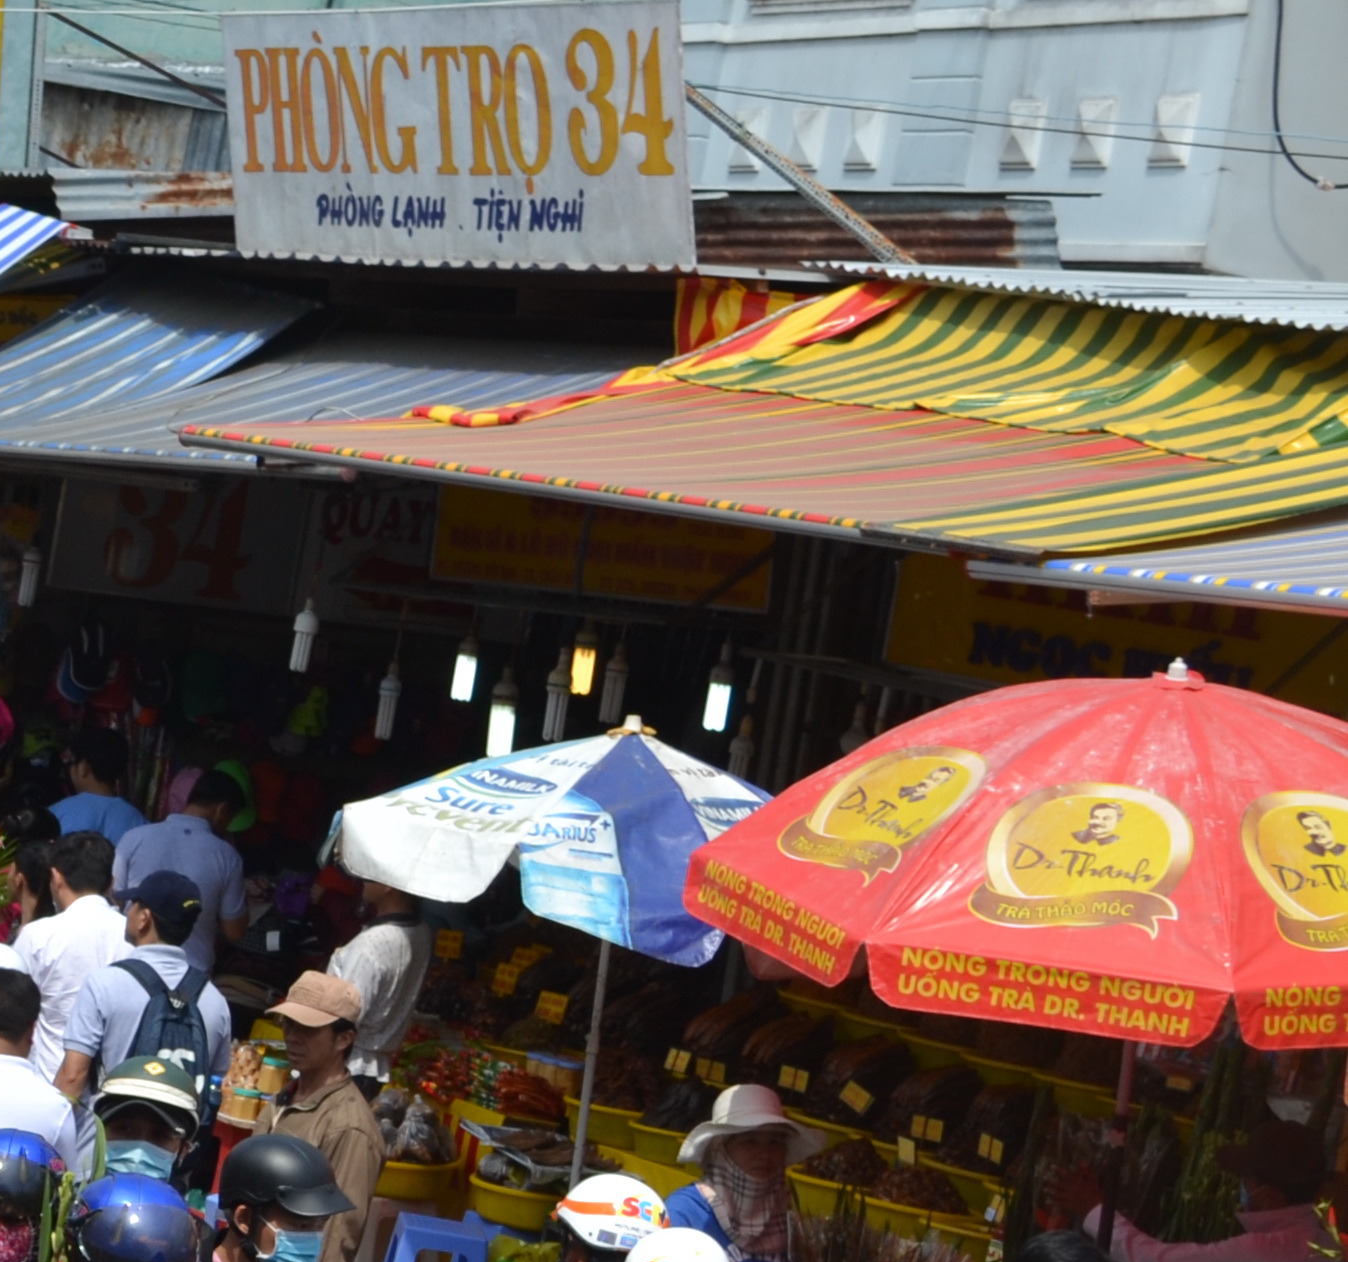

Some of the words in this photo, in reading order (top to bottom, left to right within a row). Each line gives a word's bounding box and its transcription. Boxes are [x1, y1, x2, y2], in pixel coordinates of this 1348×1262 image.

[234, 30, 419, 175] PHÒNG
[421, 44, 554, 195] TRỌ
[565, 26, 675, 177] 34
[317, 183, 384, 228] PHÒNG
[391, 195, 447, 237] LẠNH
[103, 481, 254, 601] 34
[424, 786, 515, 816] Sure
[750, 879, 796, 920] TRONG
[996, 902, 1032, 920] TRÀ
[1035, 899, 1086, 919] THẢO
[1091, 899, 1135, 918] MỘC
[738, 902, 763, 932] TRÀ
[764, 920, 785, 948] DR.
[787, 933, 836, 975] THANH
[897, 970, 981, 1003] UỐNG
[989, 982, 1037, 1012] TRÀ
[1044, 994, 1086, 1021] DR.
[1095, 1003, 1190, 1038] THANH
[901, 944, 987, 977] NÓNG
[996, 958, 1092, 992] TRONG
[1099, 973, 1196, 1010] NGƯỜI
[1265, 982, 1342, 1008] NÓNG
[1263, 1009, 1336, 1036] UỐNG
